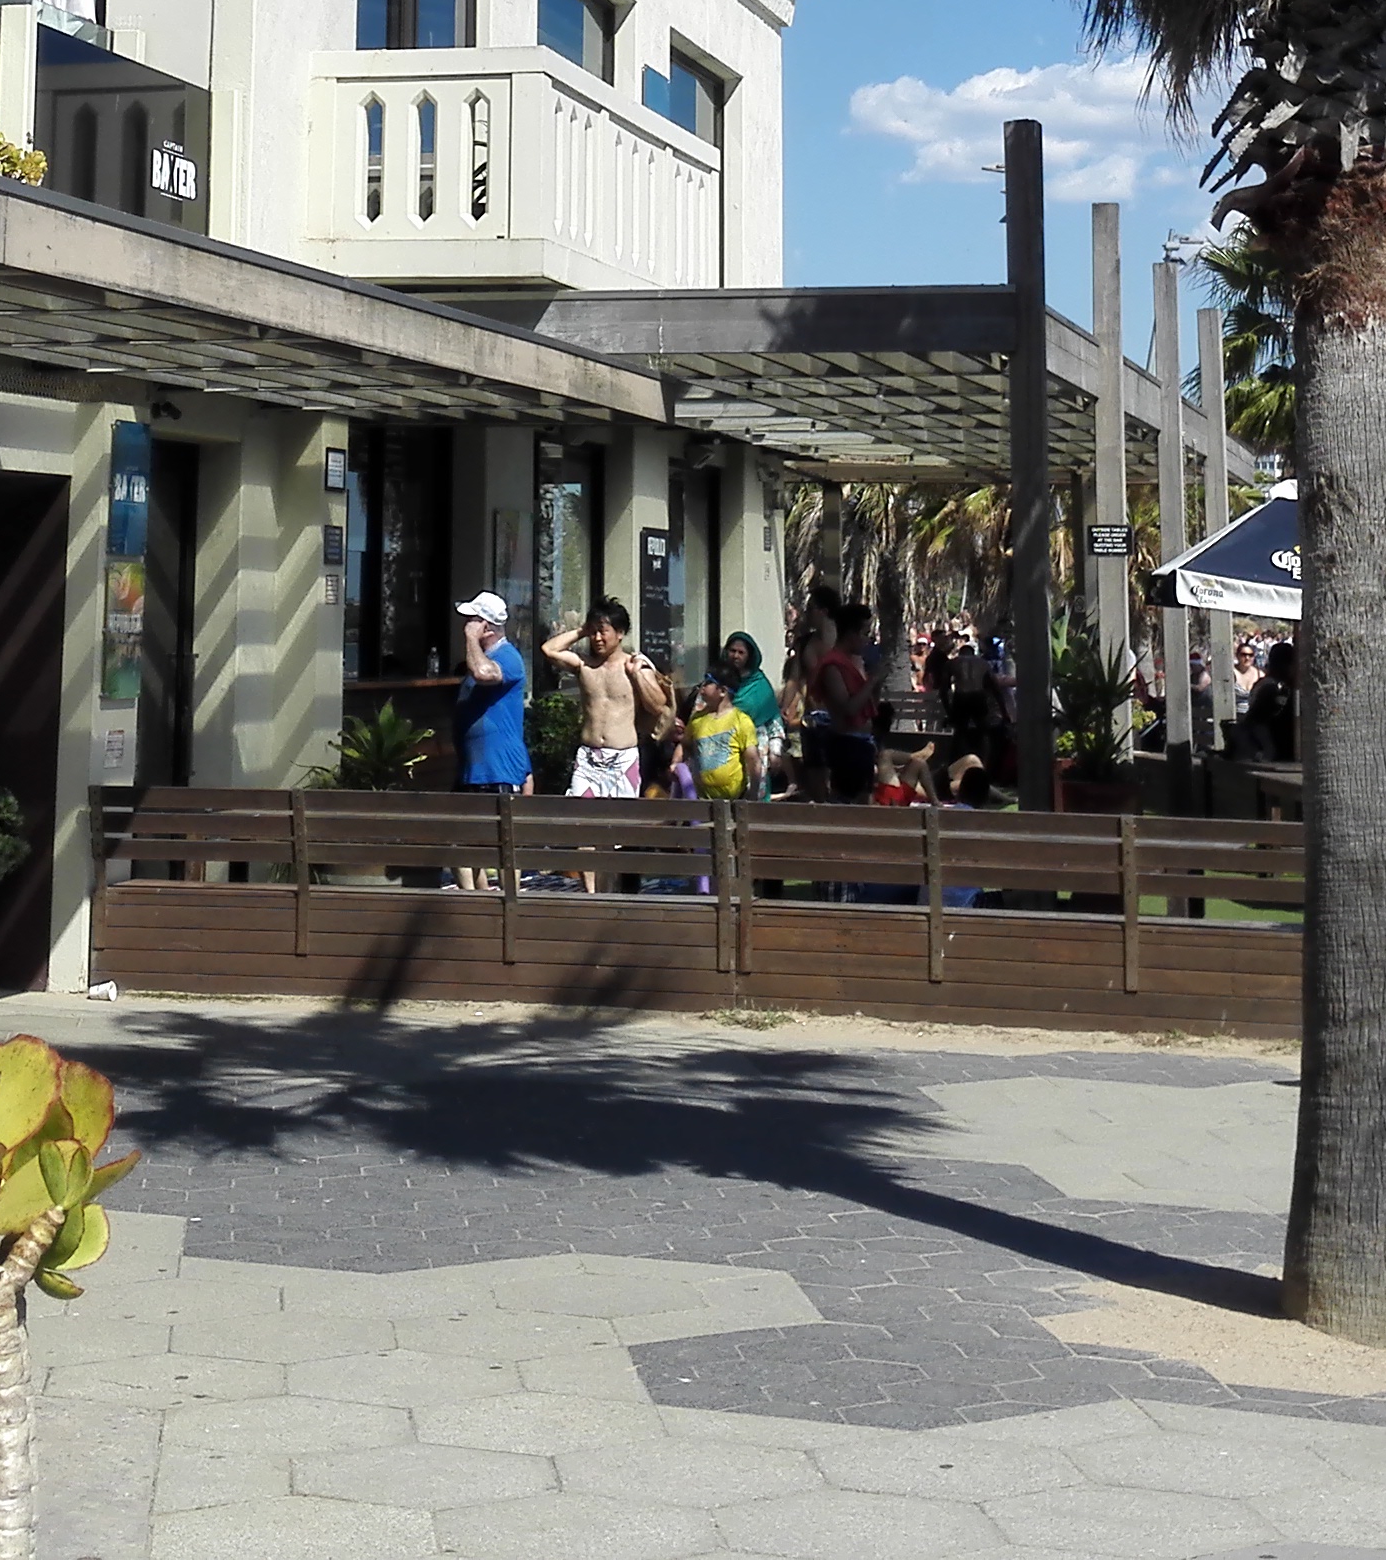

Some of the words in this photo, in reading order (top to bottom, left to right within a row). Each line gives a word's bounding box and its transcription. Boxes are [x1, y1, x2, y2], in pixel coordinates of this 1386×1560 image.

[151, 148, 196, 200] BAXTER
[113, 472, 146, 503] BAXTER
[1190, 584, 1224, 598] Corona
